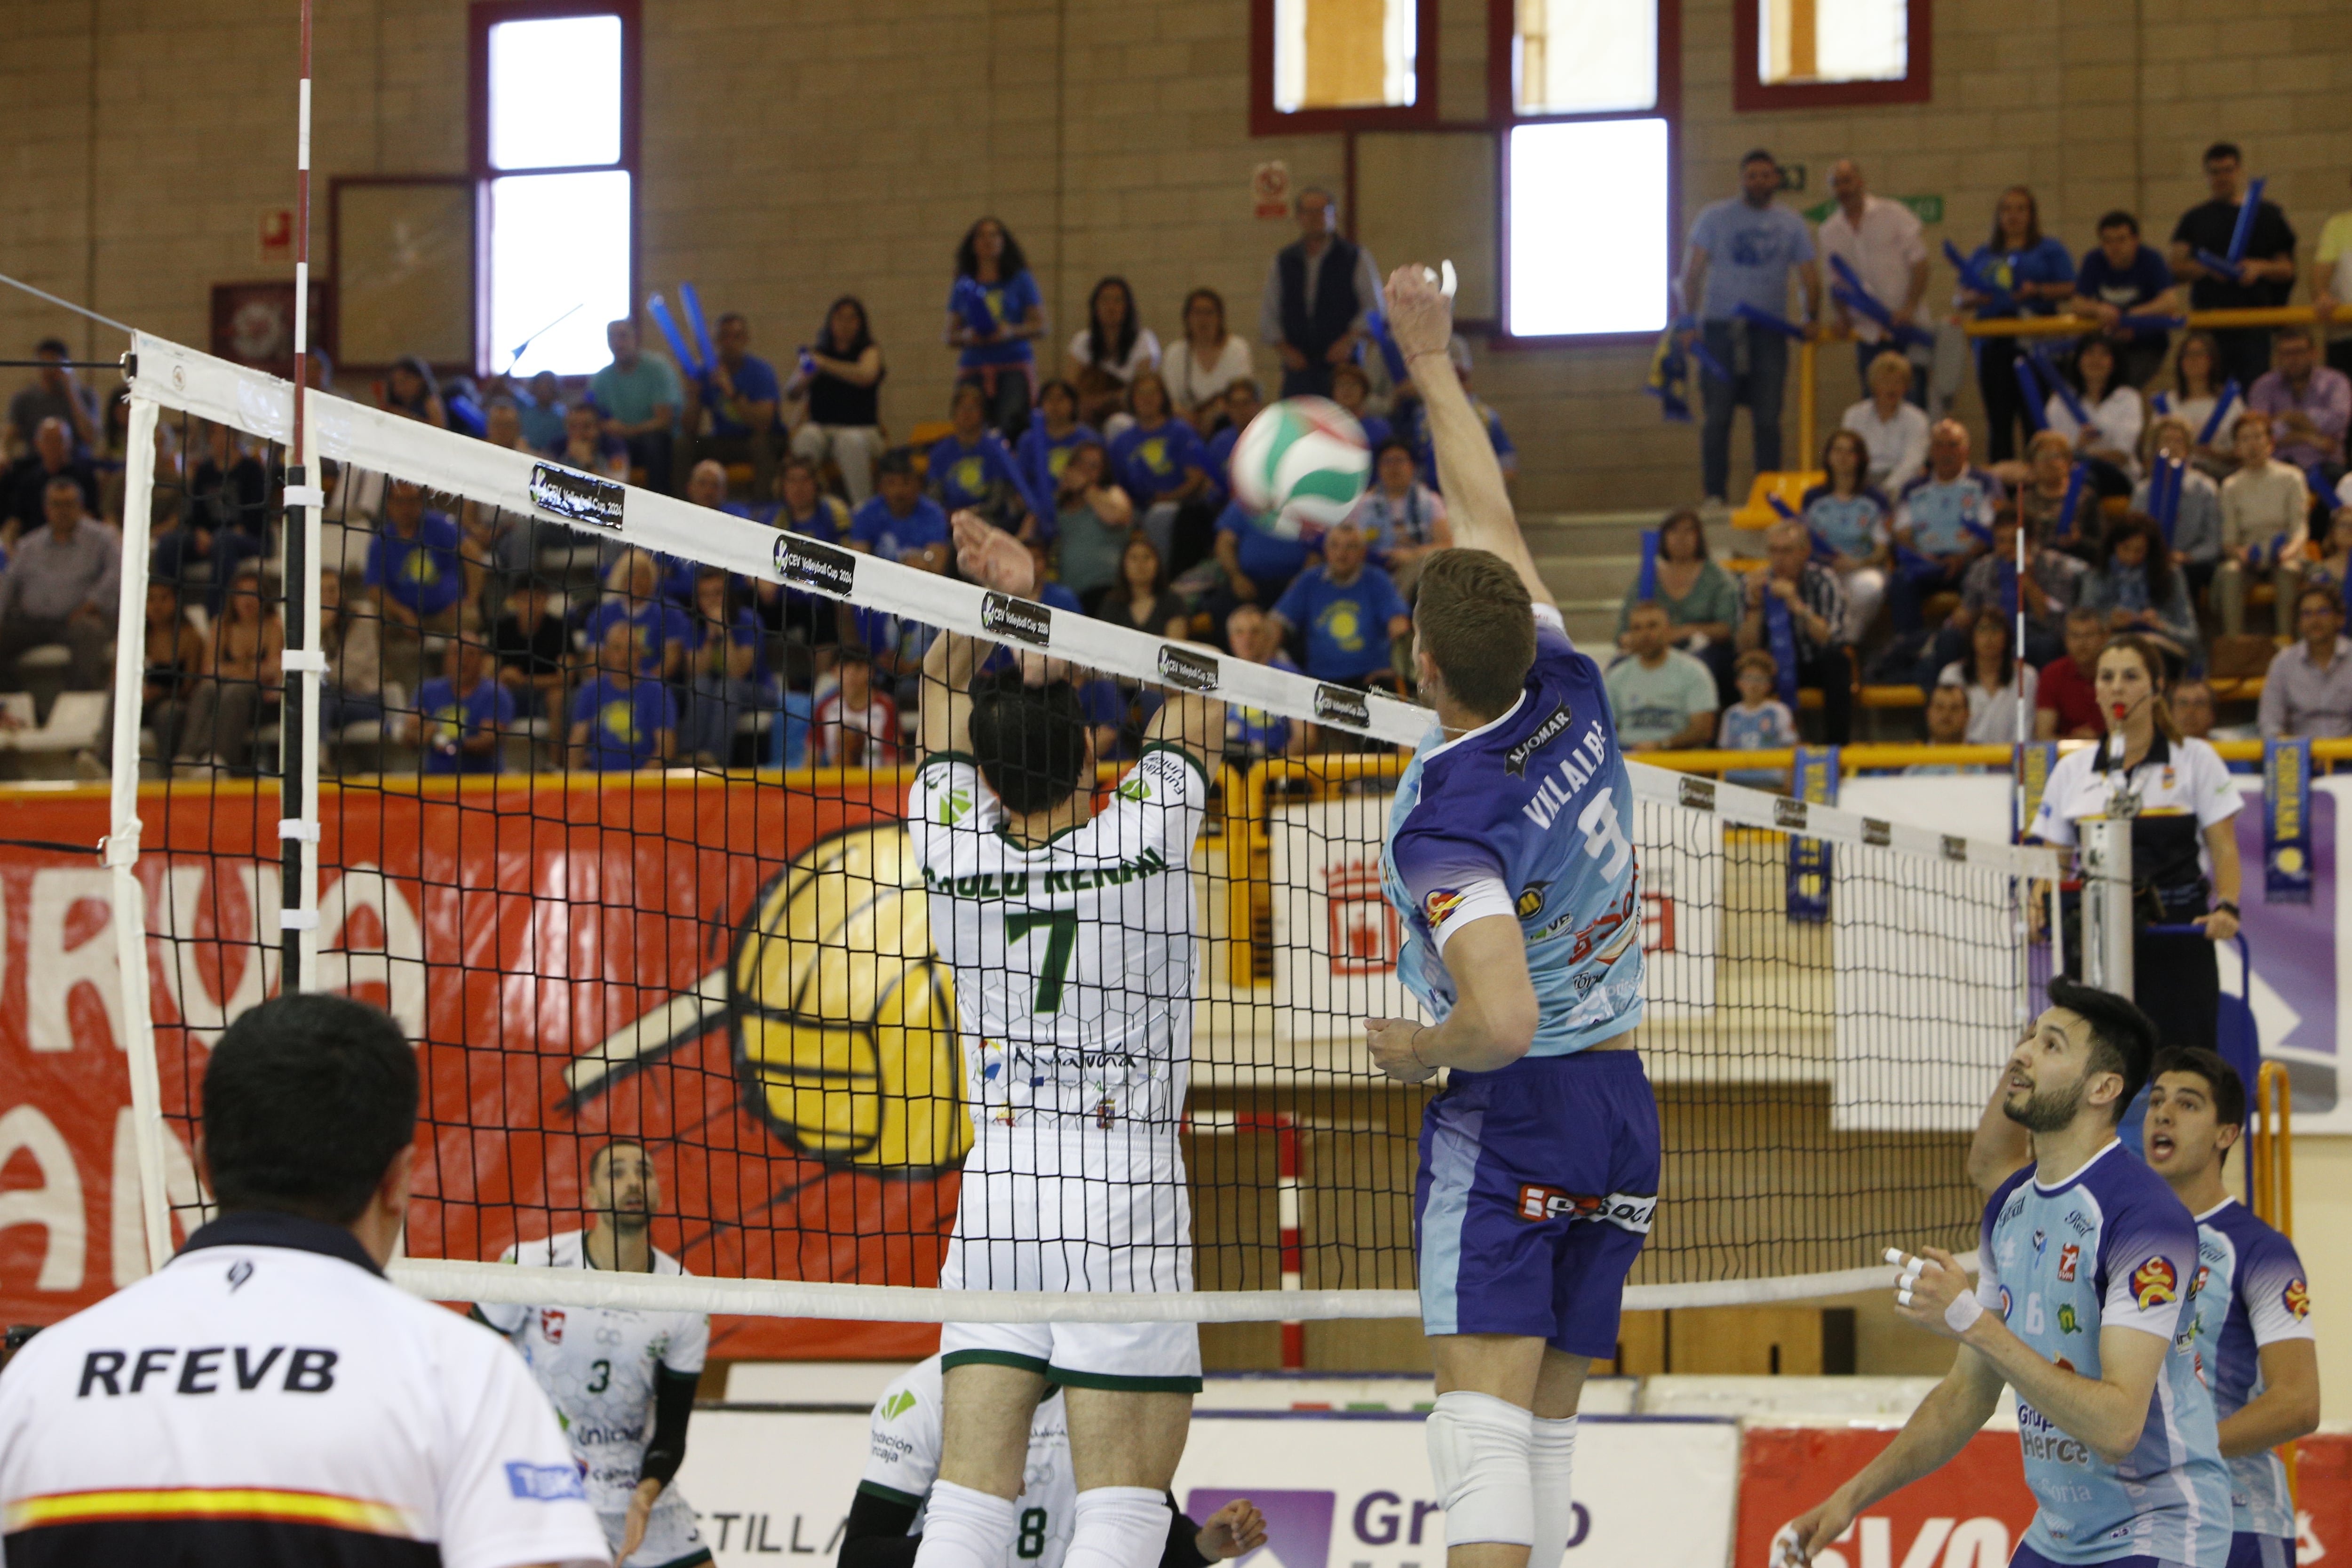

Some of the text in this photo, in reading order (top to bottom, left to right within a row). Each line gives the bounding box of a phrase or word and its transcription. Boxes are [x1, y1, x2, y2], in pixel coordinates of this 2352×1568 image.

[593, 497, 606, 515] Cup
[607, 501, 622, 517] 2024
[788, 553, 852, 585] CEV Volleyball Cup 2024
[994, 608, 1005, 622] CEV
[1006, 612, 1027, 629] Volleyball
[1027, 618, 1037, 634] Cup
[1510, 711, 1569, 764] ALJOMAR
[1577, 787, 1631, 883] 9
[1006, 908, 1078, 1014] 7
[2026, 1292, 2045, 1336] 6
[77, 1345, 339, 1398] RFEVB
[588, 1360, 611, 1393] 3
[1017, 1507, 1047, 1559] 8
